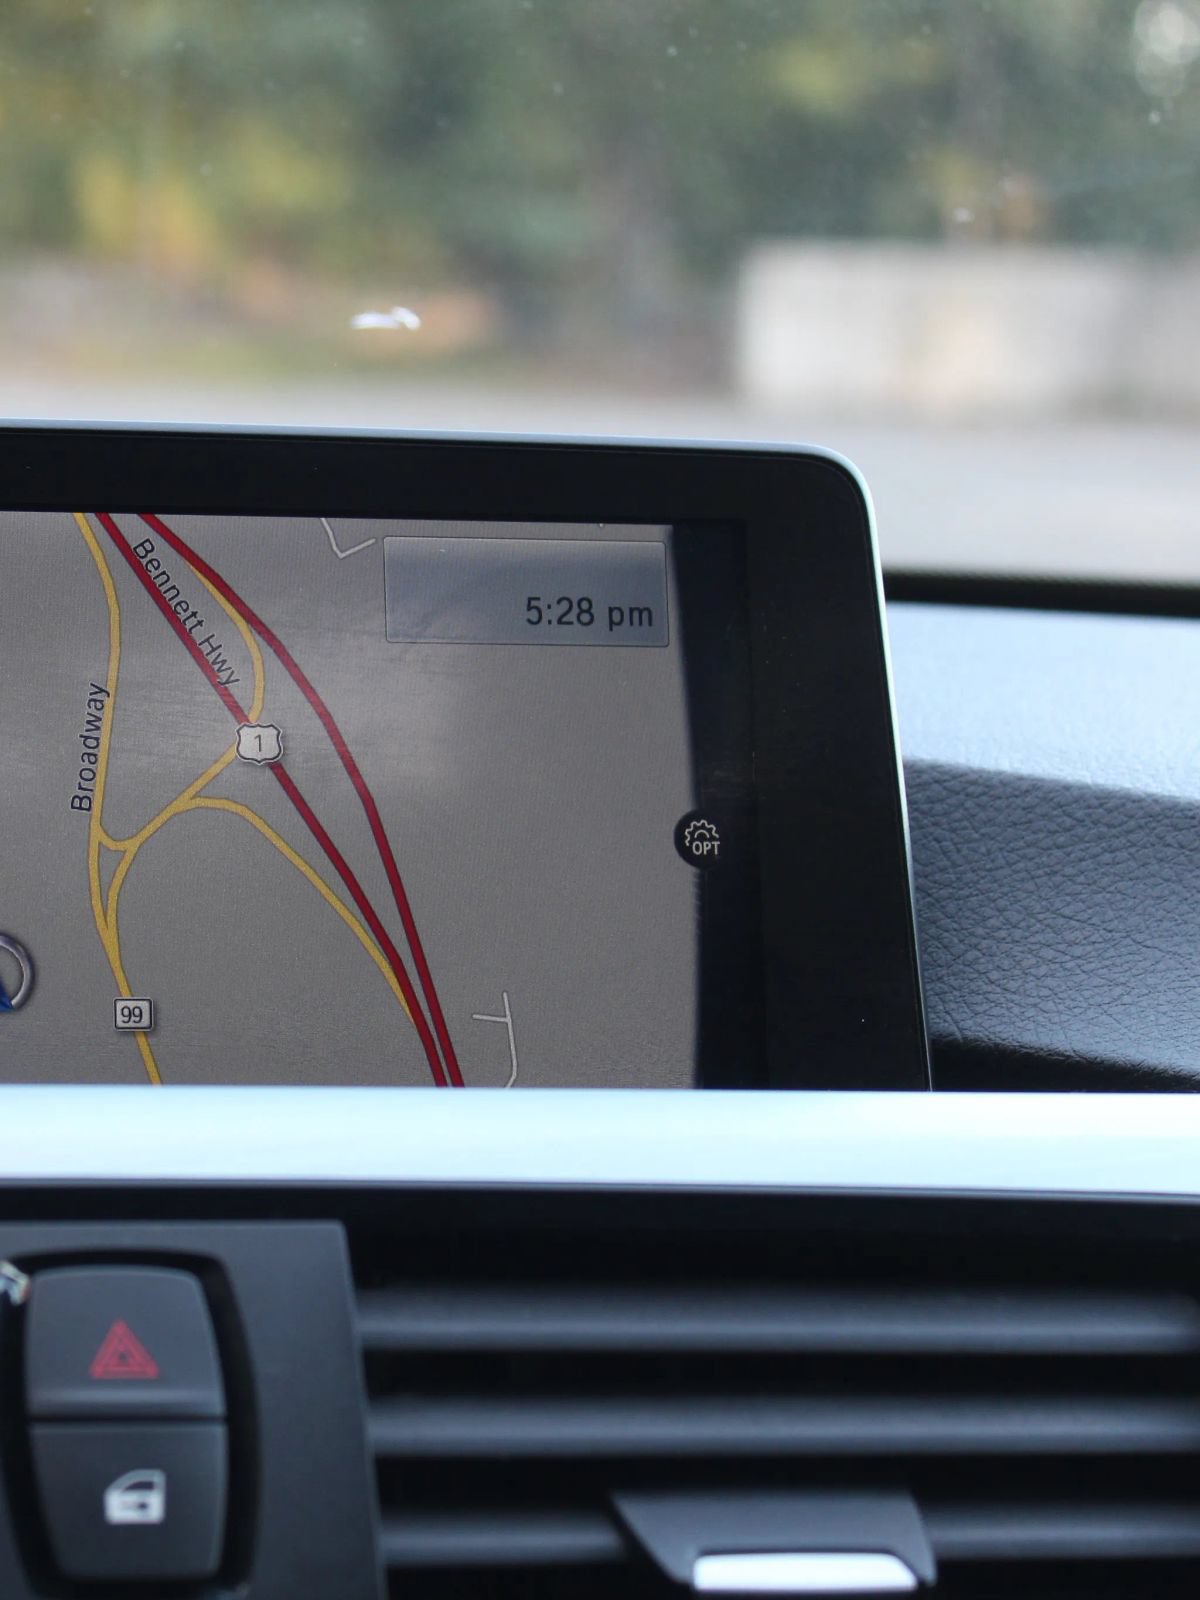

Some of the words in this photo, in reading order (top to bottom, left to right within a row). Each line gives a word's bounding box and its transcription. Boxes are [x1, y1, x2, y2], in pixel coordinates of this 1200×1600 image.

[133, 538, 204, 635] Bennett
[198, 634, 240, 687] Hwy
[526, 596, 594, 626] 5:28
[608, 606, 653, 632] pm
[71, 682, 110, 812] Broadway
[254, 734, 262, 753] 1
[692, 841, 720, 855] OPT
[121, 1005, 143, 1024] 99
